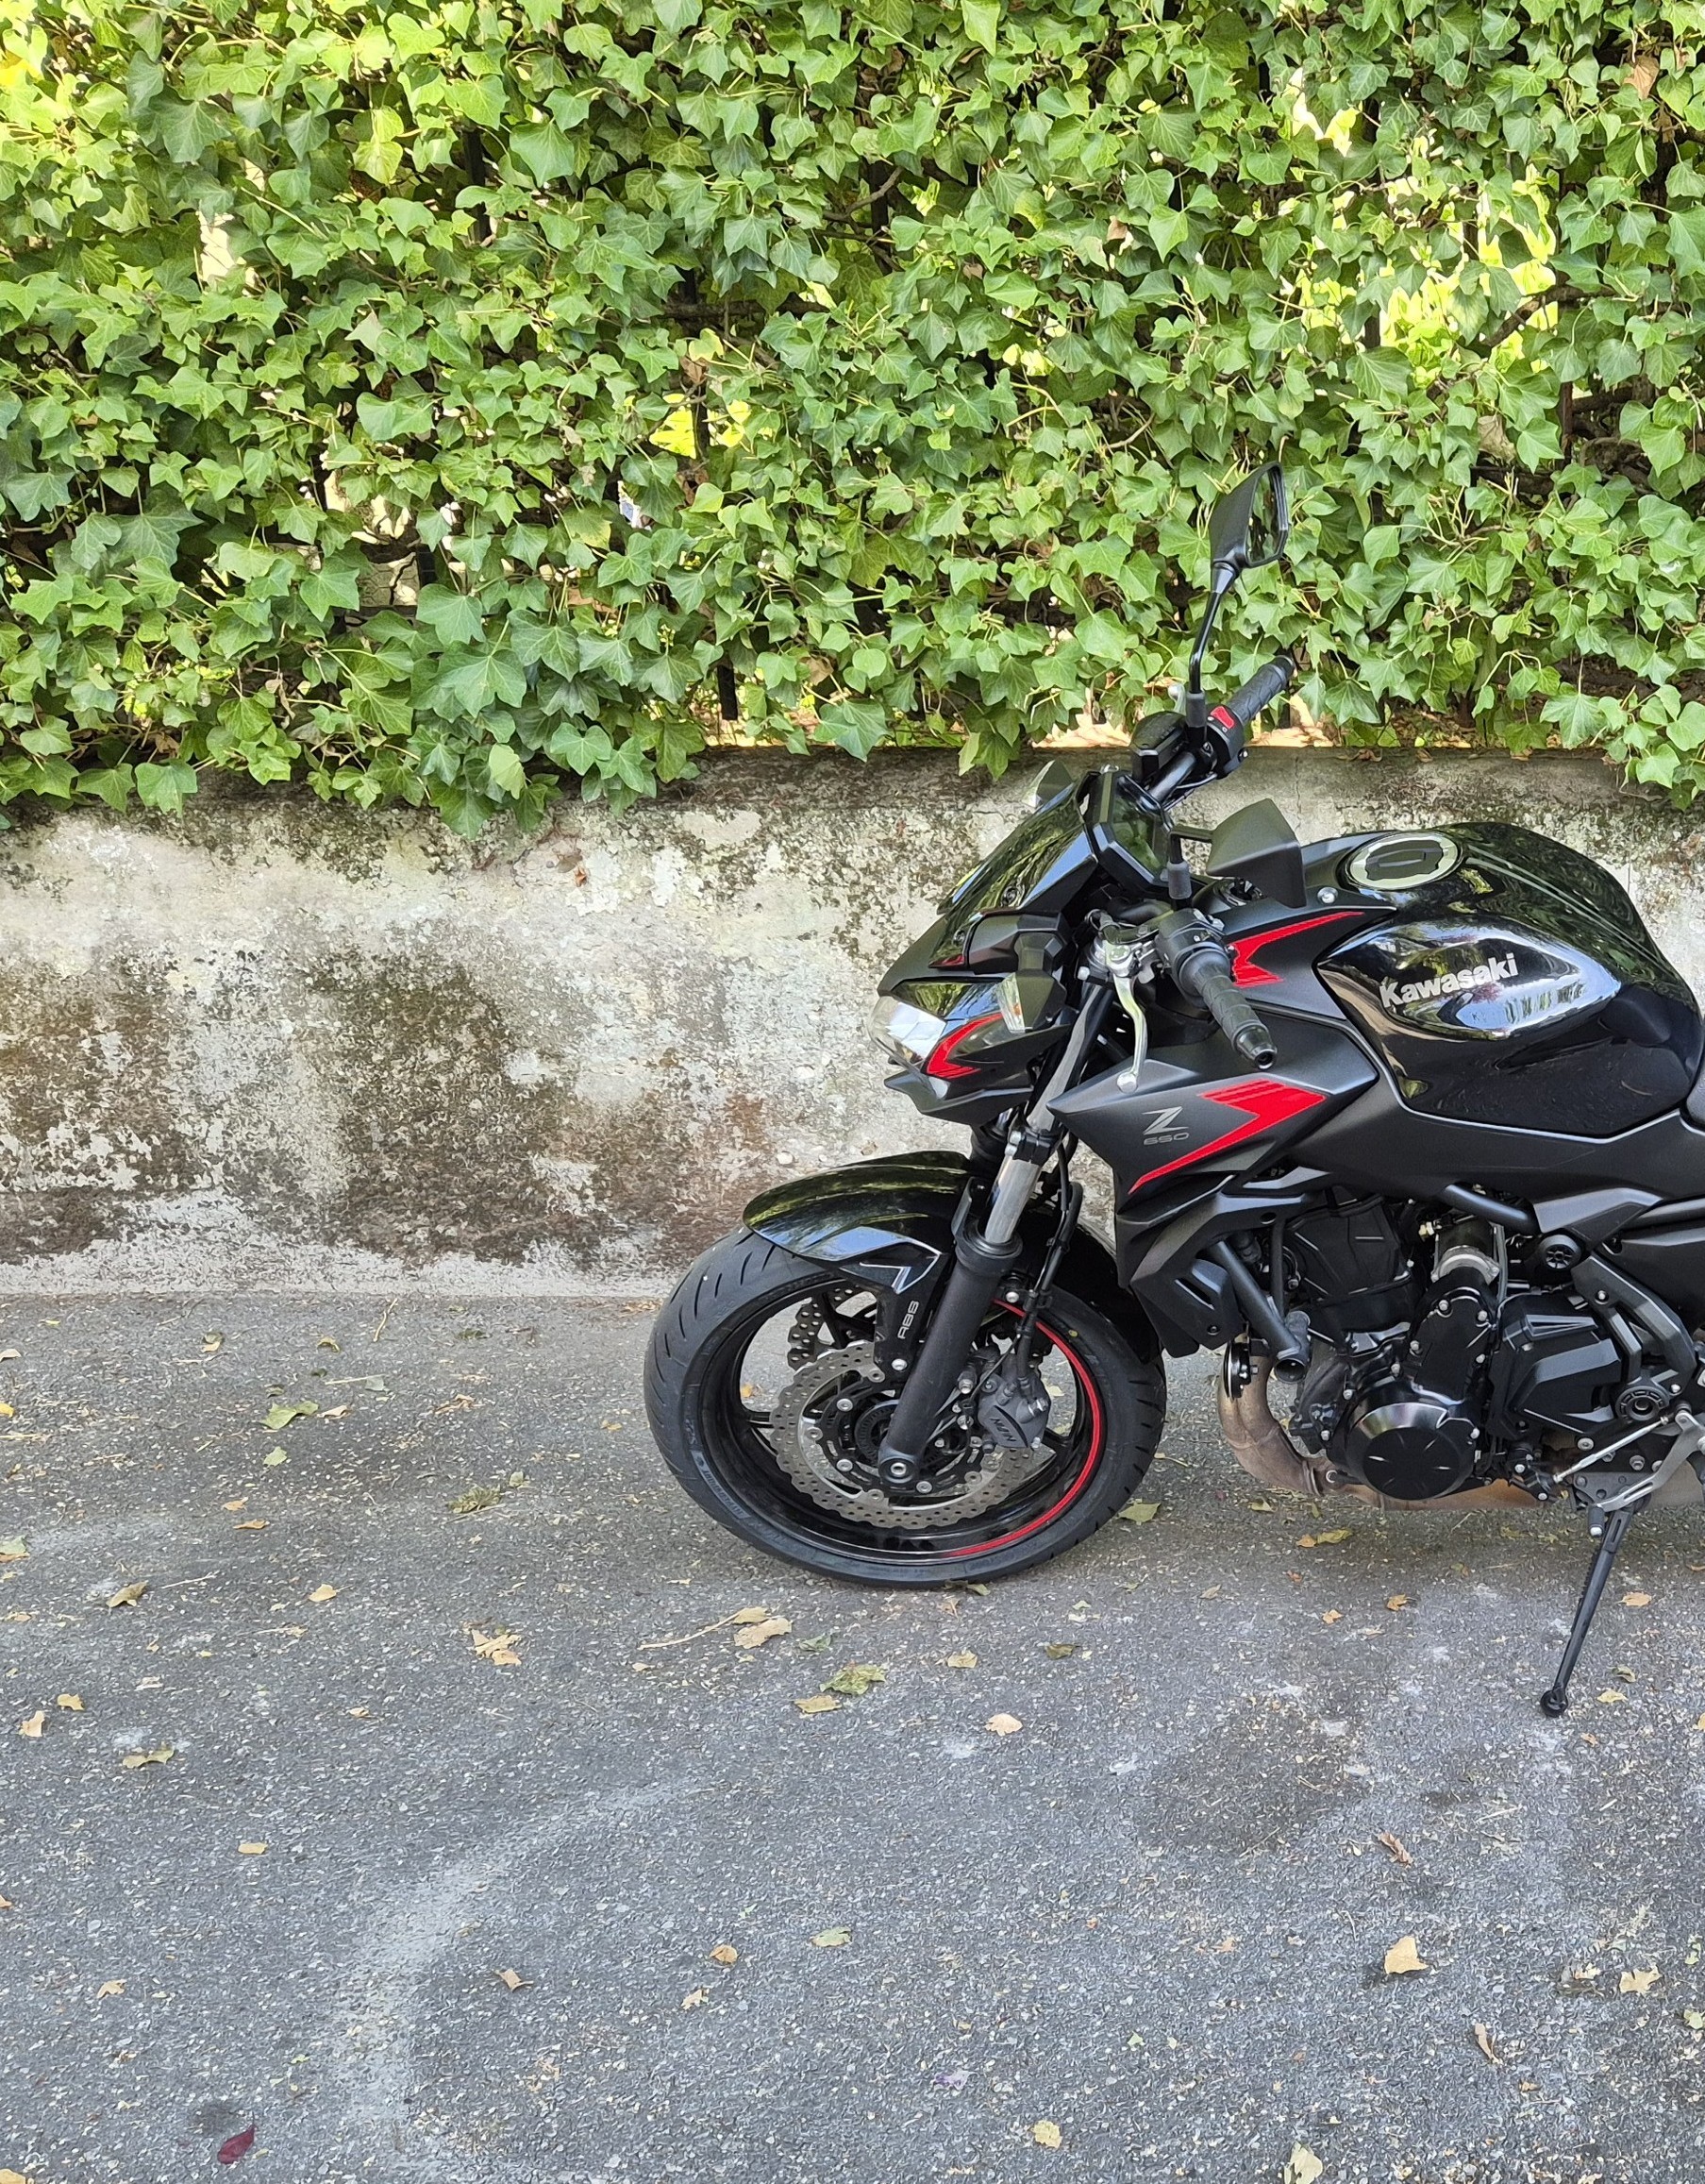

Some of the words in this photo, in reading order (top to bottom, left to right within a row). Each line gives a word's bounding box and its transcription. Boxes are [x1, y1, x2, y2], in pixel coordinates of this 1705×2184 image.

[1379, 952, 1519, 1008] Kawasaki
[1142, 1106, 1189, 1135] Z
[1144, 1133, 1189, 1145] 650
[897, 1301, 919, 1339] ABS
